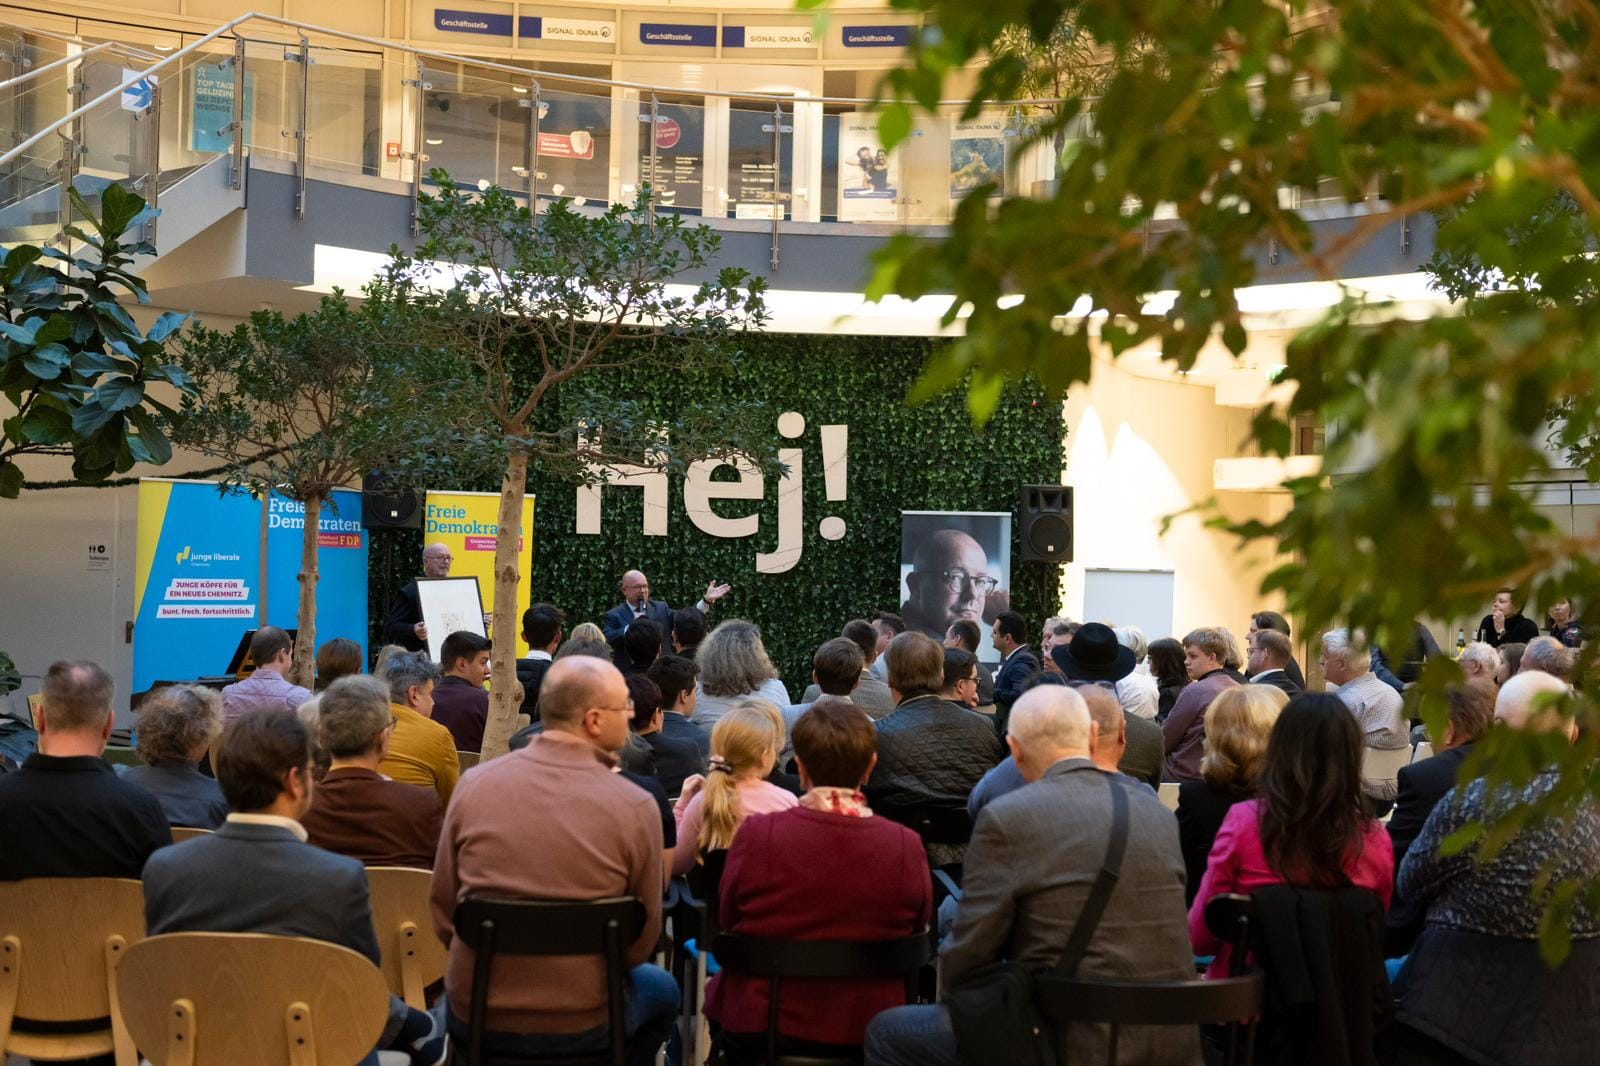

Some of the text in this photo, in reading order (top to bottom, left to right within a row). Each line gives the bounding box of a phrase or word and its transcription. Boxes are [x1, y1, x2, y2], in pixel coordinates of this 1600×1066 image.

[441, 18, 489, 30] Geschäftsstelle
[547, 27, 573, 35] SIGNAL
[646, 32, 693, 41] Geschäftsstelle
[750, 35, 776, 43] SIGNAL
[848, 34, 895, 43] Geschäftsstelle
[197, 80, 235, 91] TOP TAGE
[196, 88, 235, 99] GELDZIN
[196, 102, 231, 112] WECHSE
[269, 498, 305, 513] Freie
[427, 505, 466, 518] Freie
[269, 514, 361, 532] Demkraten
[191, 553, 240, 562] junge liberale
[200, 581, 222, 589] KÖPFE
[224, 581, 238, 589] FÜR
